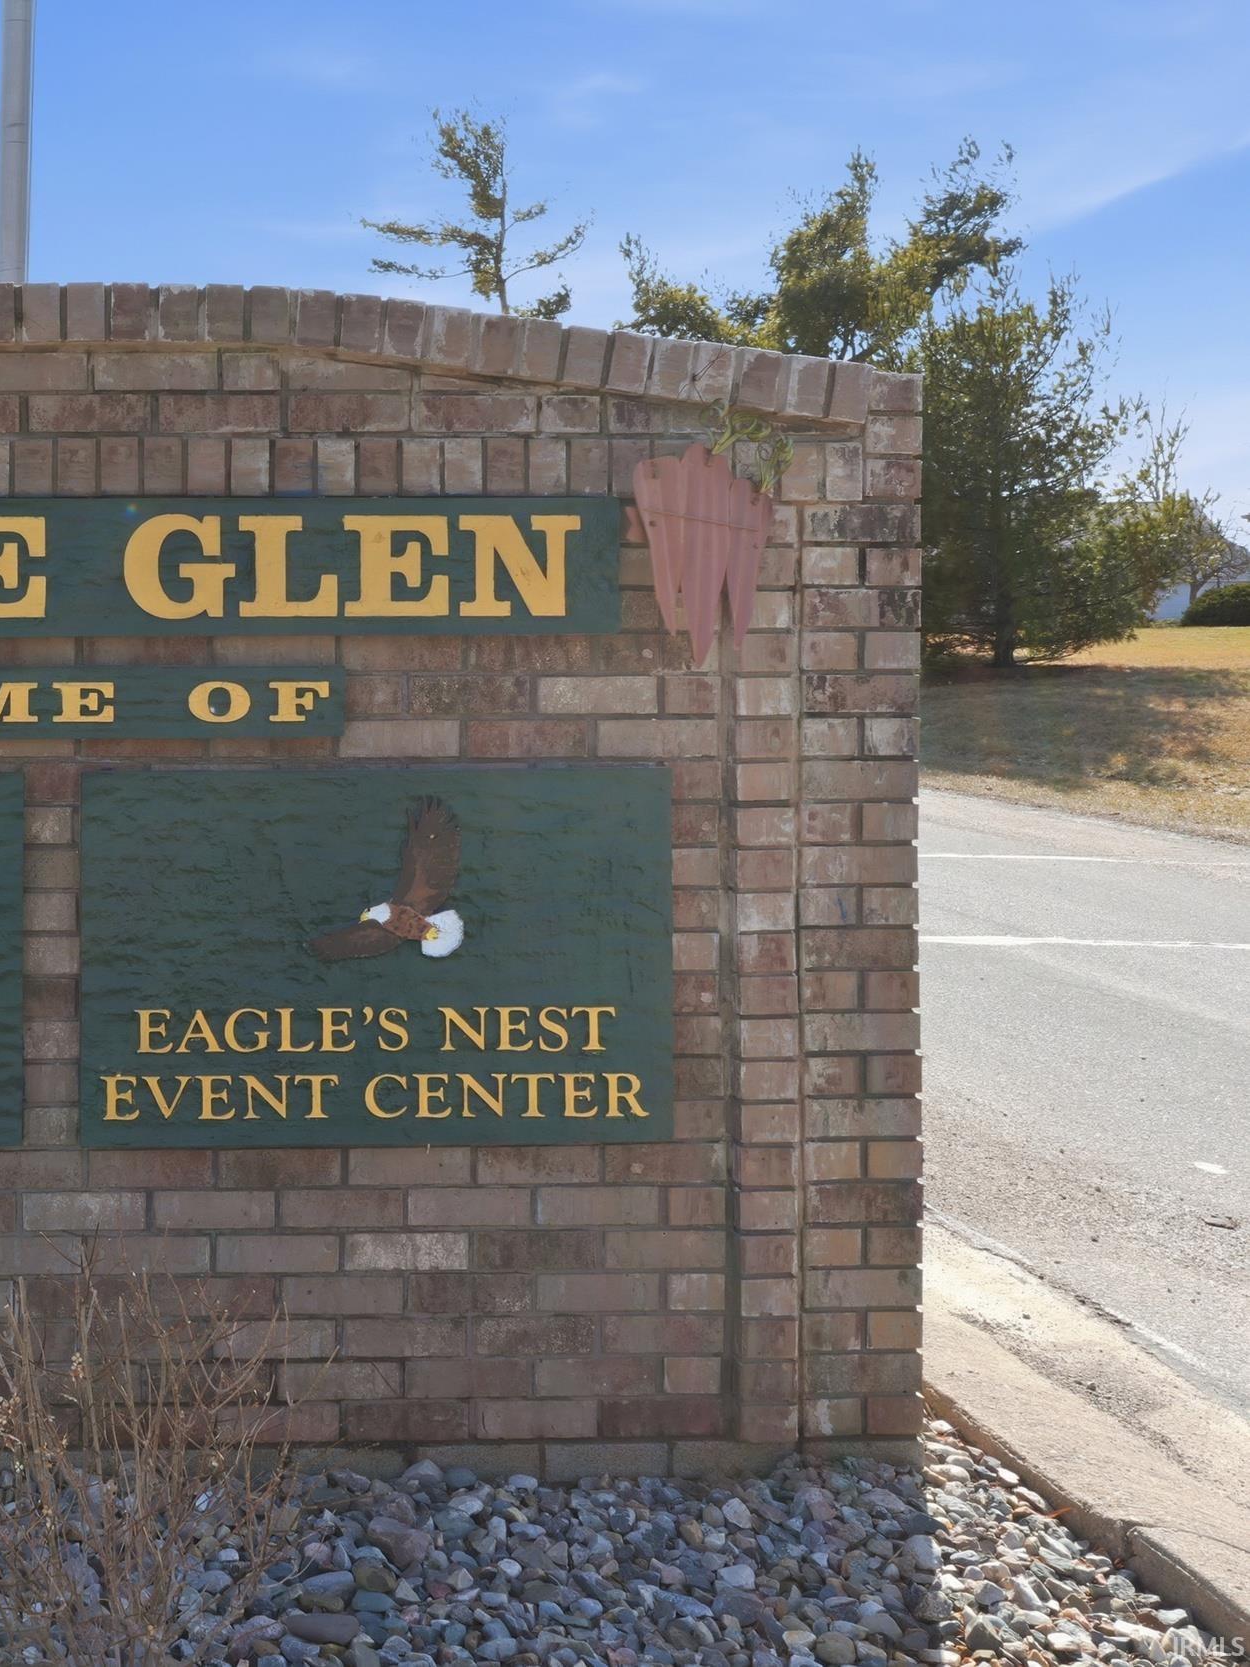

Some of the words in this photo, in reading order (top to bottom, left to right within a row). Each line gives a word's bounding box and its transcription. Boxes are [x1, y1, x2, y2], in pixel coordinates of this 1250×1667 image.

[123, 513, 581, 620] GLEN
[188, 681, 330, 723] OF
[136, 1007, 409, 1054] EAGLE'S
[438, 1006, 616, 1052] NEST
[101, 1074, 339, 1121] EVENT
[364, 1073, 650, 1118] CENTER
